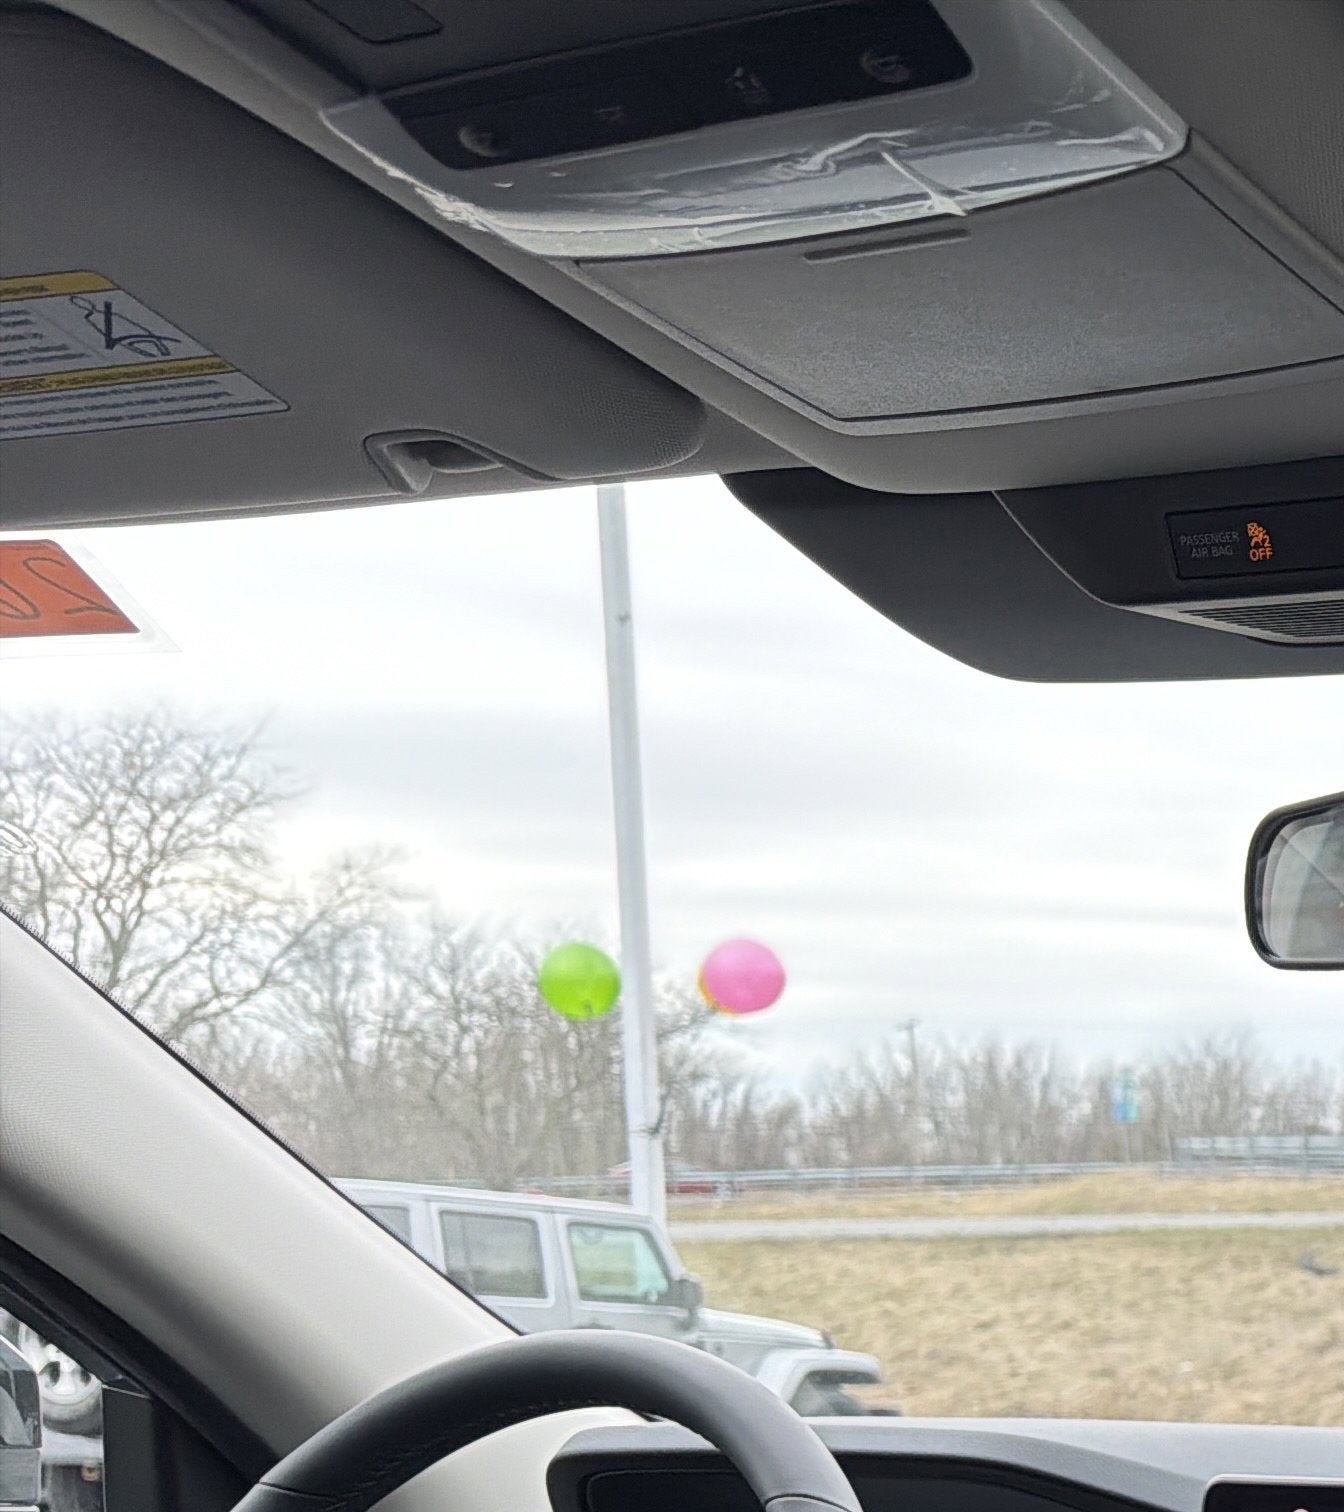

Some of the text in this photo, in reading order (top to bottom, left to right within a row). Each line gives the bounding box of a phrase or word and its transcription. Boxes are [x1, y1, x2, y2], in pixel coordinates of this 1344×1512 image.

[1180, 531, 1240, 546] PASSENGER
[1191, 545, 1233, 558] AIR BAG
[1250, 548, 1273, 561] OFF
